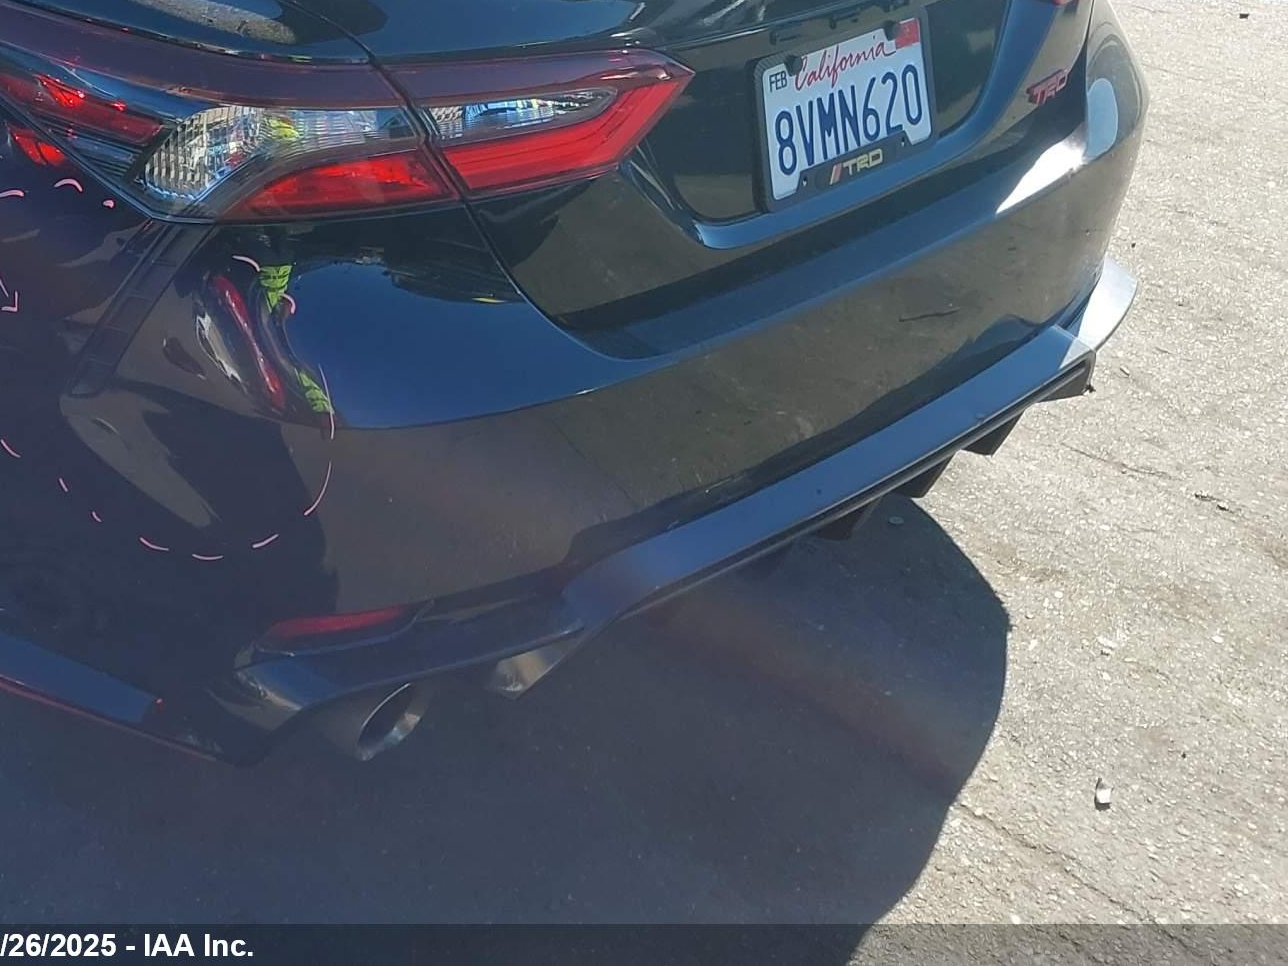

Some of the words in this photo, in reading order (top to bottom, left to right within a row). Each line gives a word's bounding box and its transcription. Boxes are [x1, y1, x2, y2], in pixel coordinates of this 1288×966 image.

[768, 70, 788, 93] FEB
[794, 35, 896, 91] California
[775, 64, 923, 176] 8VMN620
[841, 148, 883, 176] TRD
